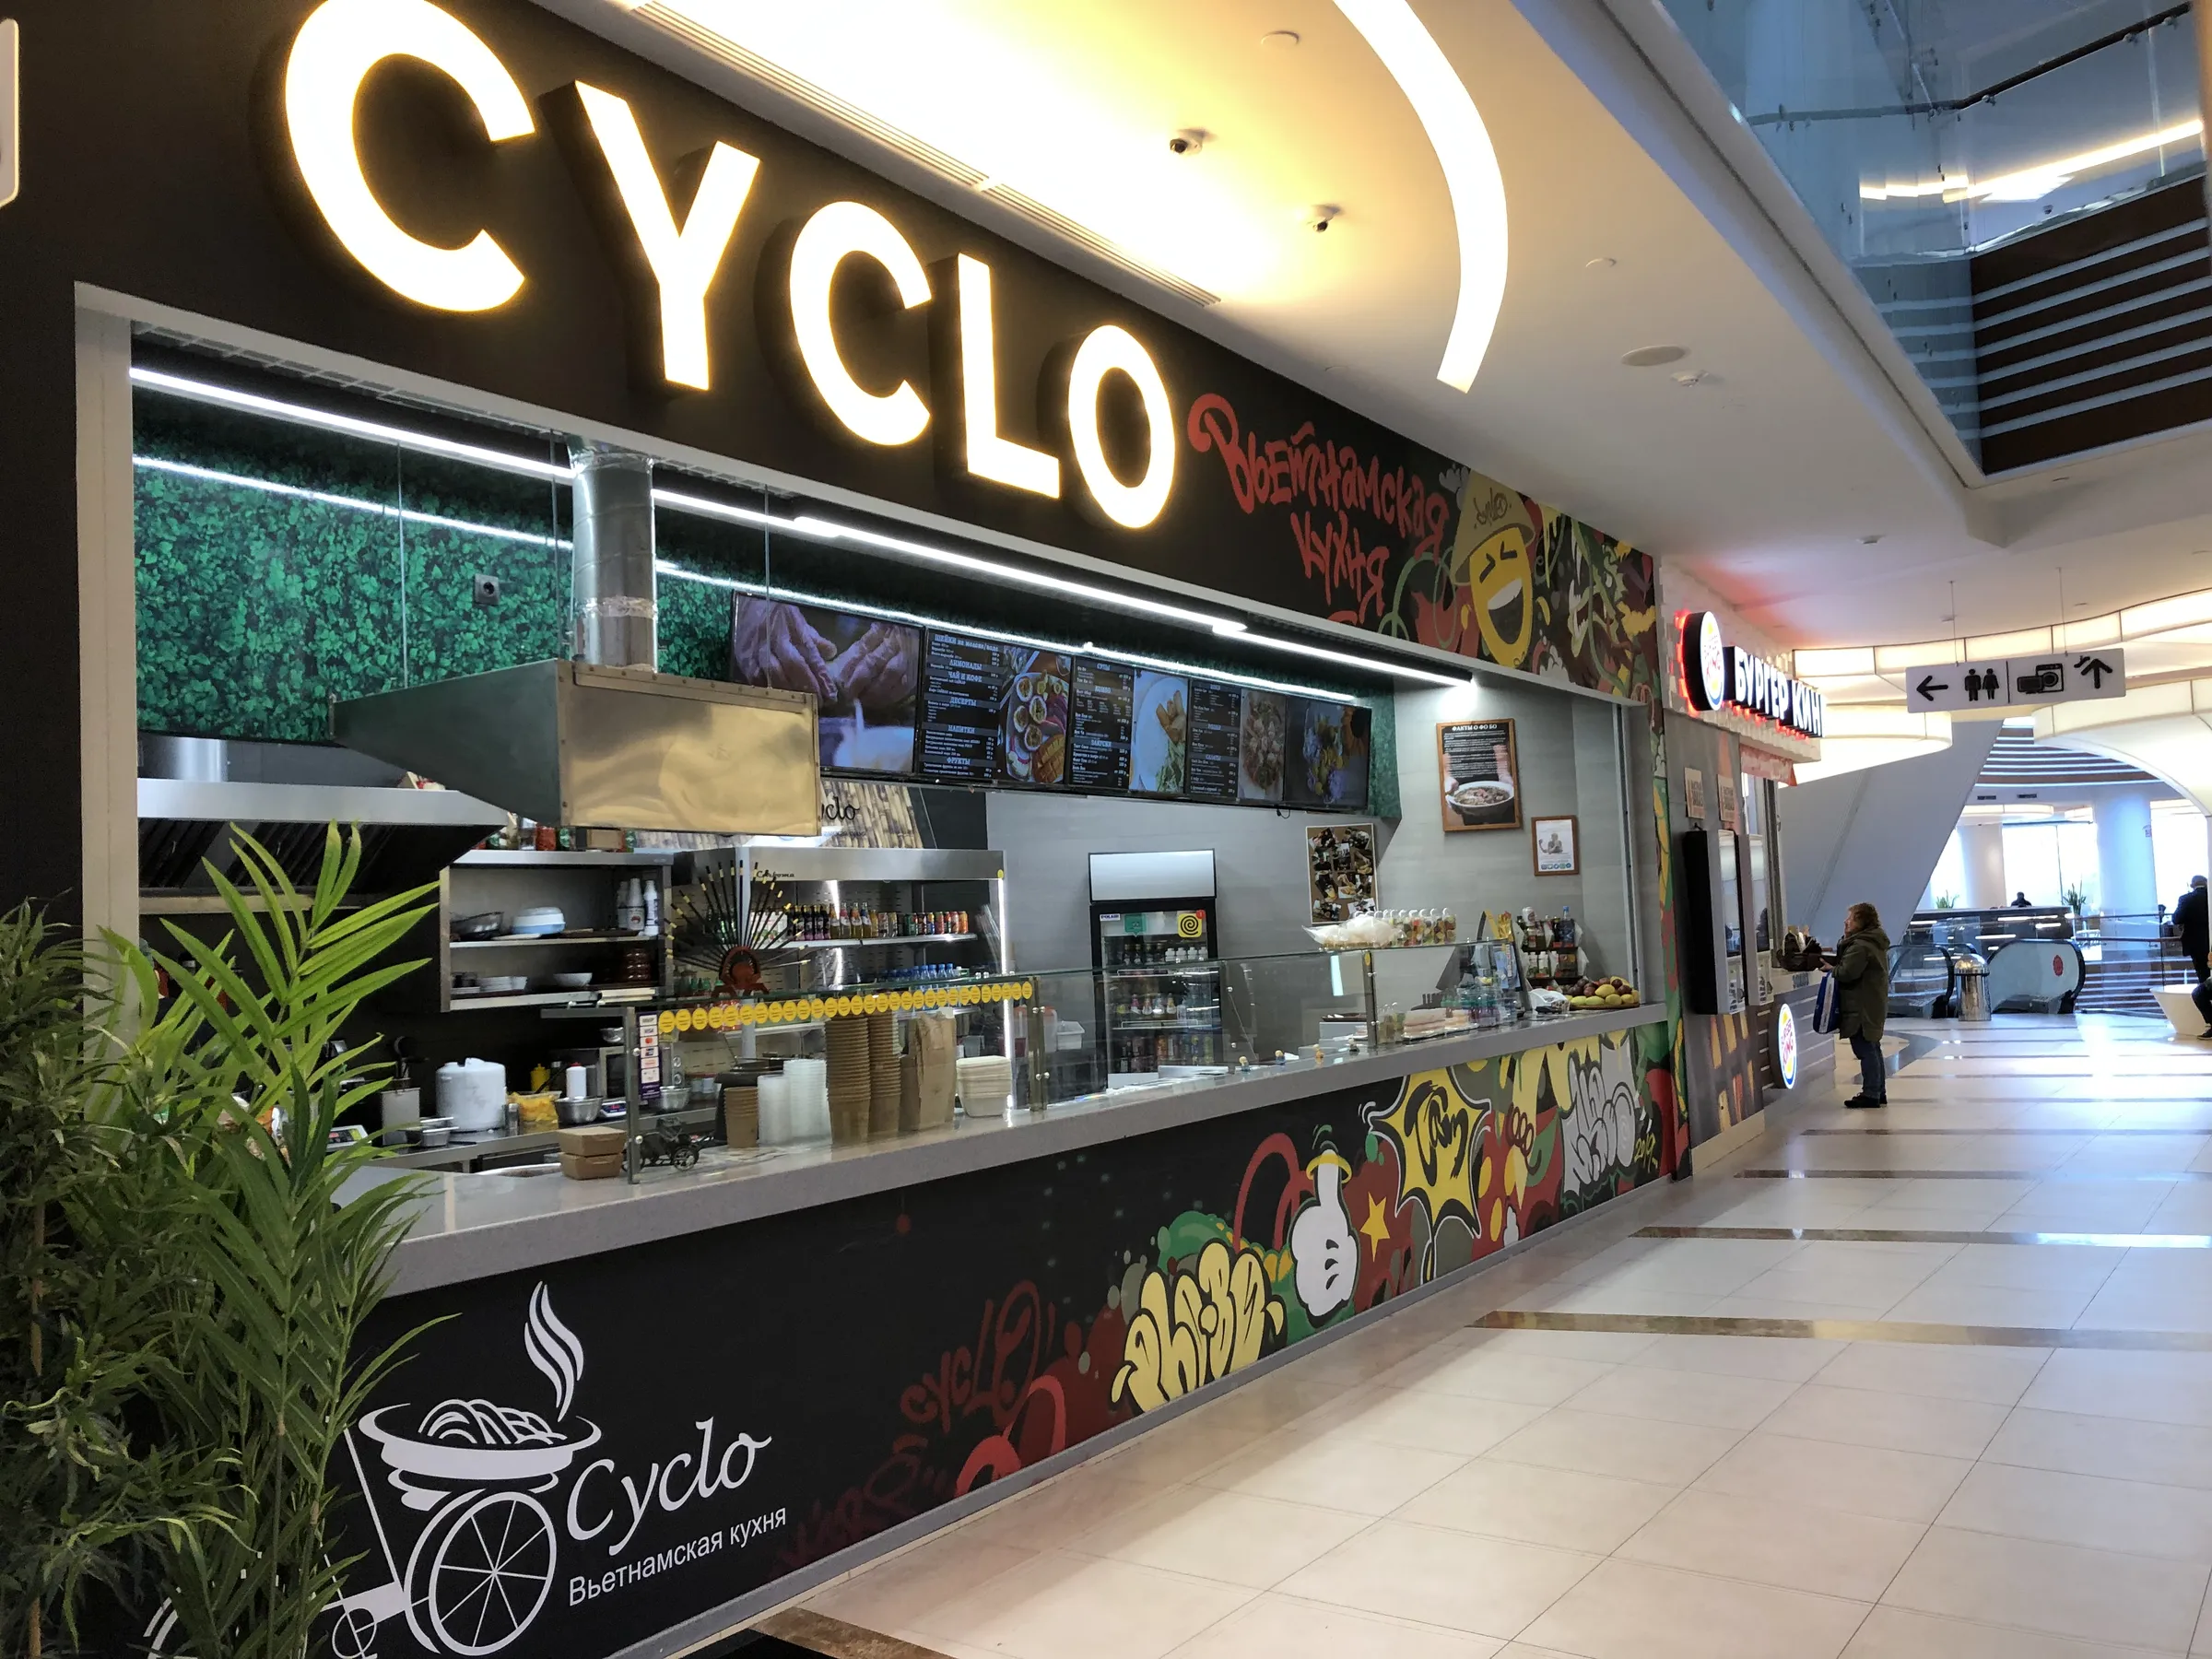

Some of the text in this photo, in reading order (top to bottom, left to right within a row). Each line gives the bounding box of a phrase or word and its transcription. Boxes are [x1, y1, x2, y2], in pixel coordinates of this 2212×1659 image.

[284, 0, 1177, 530] CYCLO
[1734, 645, 1789, 720] БУРГЕР
[946, 757, 971, 766] ФРУКТЫ
[947, 724, 975, 734] НАПИТКИ
[820, 796, 860, 820] clo
[567, 1416, 772, 1557] Cyclo
[569, 1531, 724, 1606] Вьетнамская
[729, 1507, 787, 1550] кухня
